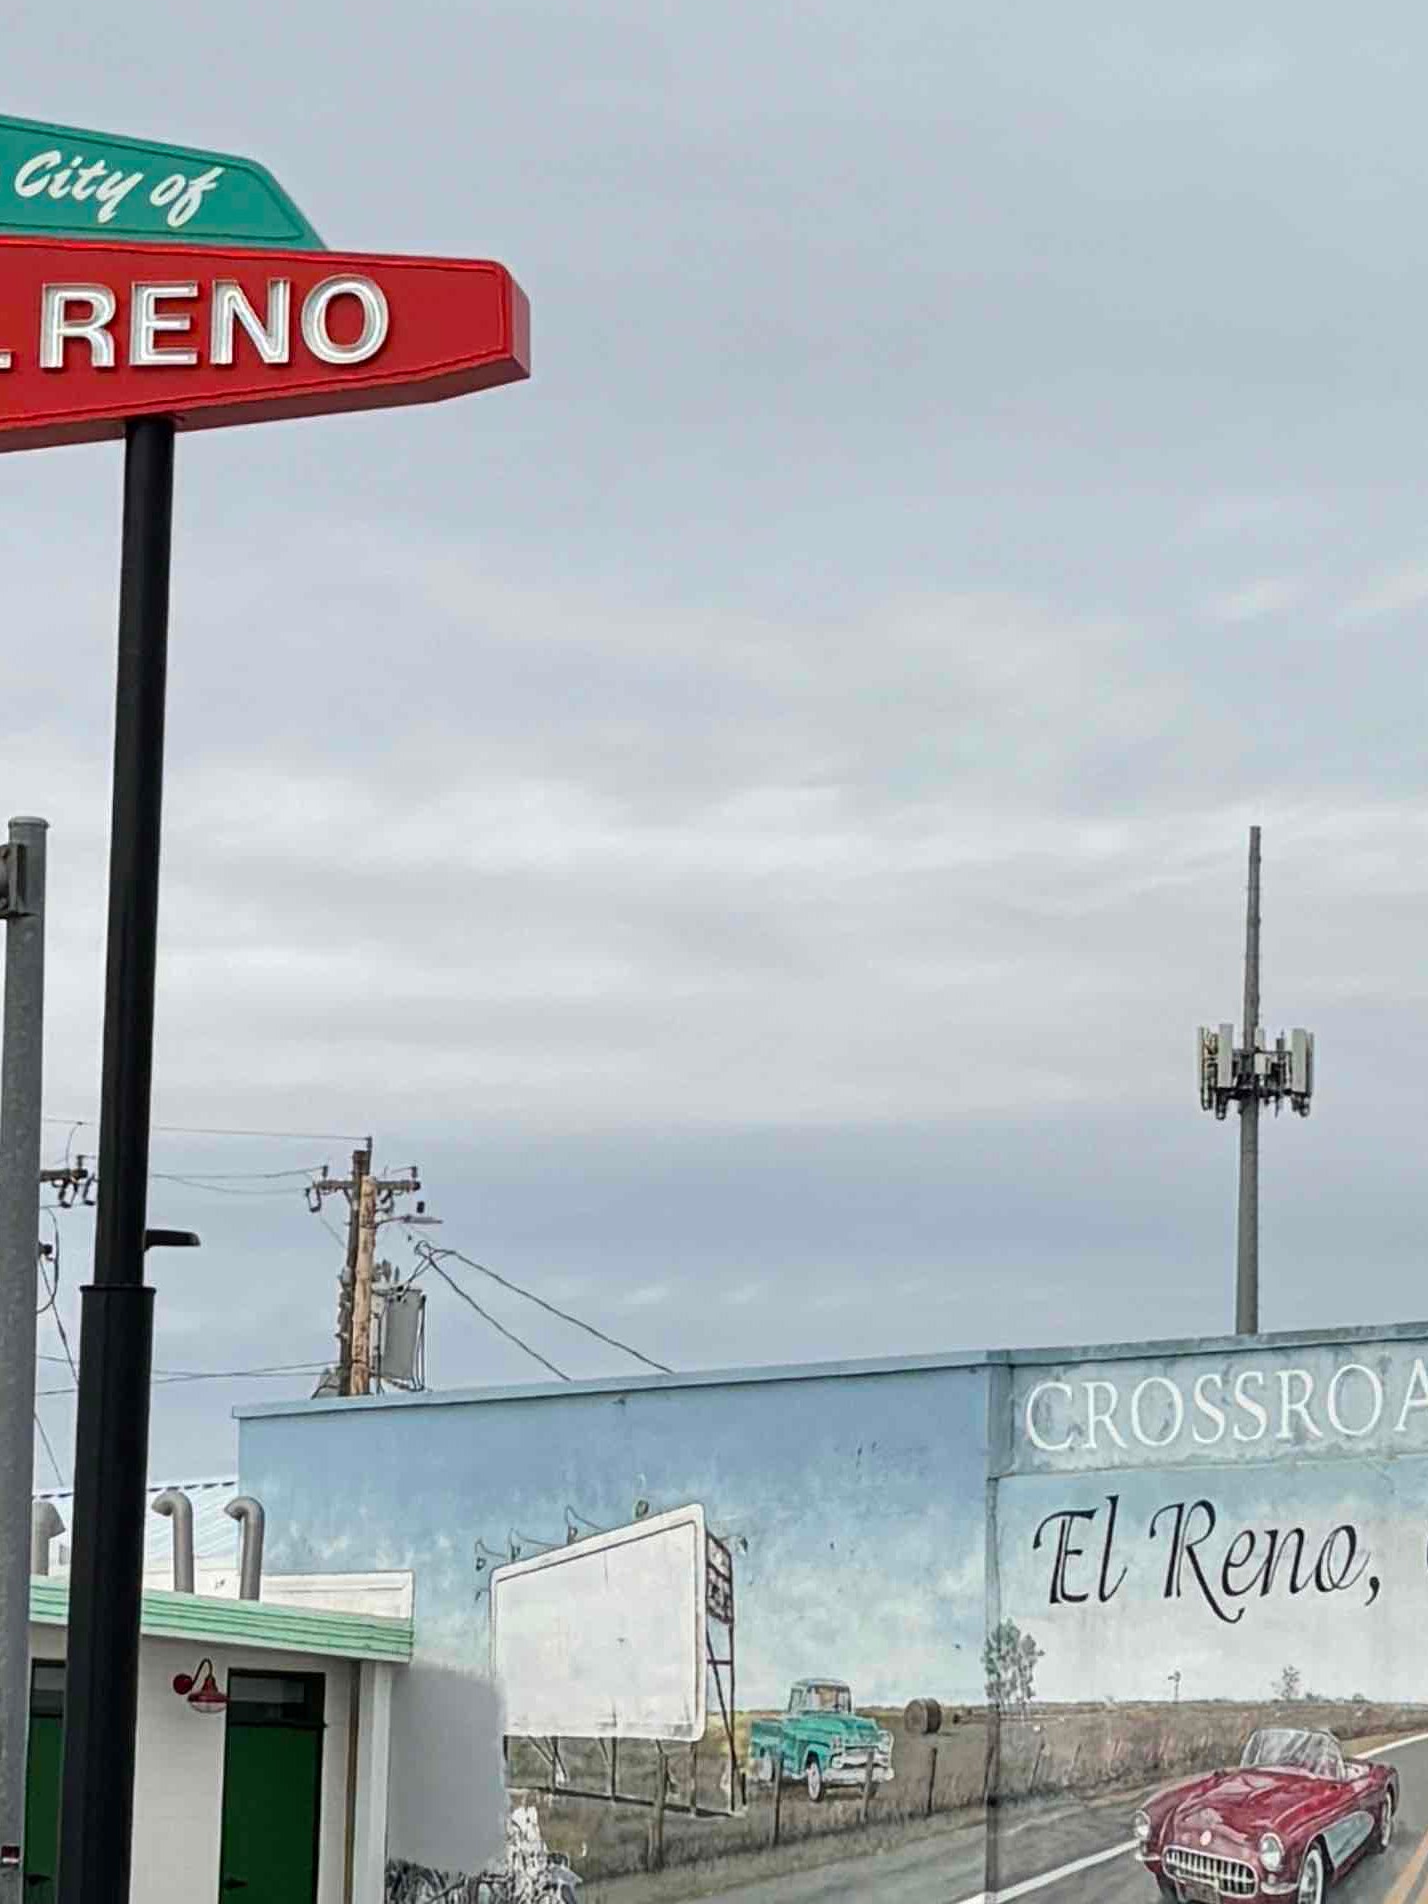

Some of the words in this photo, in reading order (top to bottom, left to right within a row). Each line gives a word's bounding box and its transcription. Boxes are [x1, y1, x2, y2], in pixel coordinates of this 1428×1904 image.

[15, 150, 144, 224] City
[149, 167, 225, 227] of
[39, 273, 390, 369] RENO
[1032, 1494, 1128, 1606] El
[1149, 1502, 1380, 1624] Reno,
